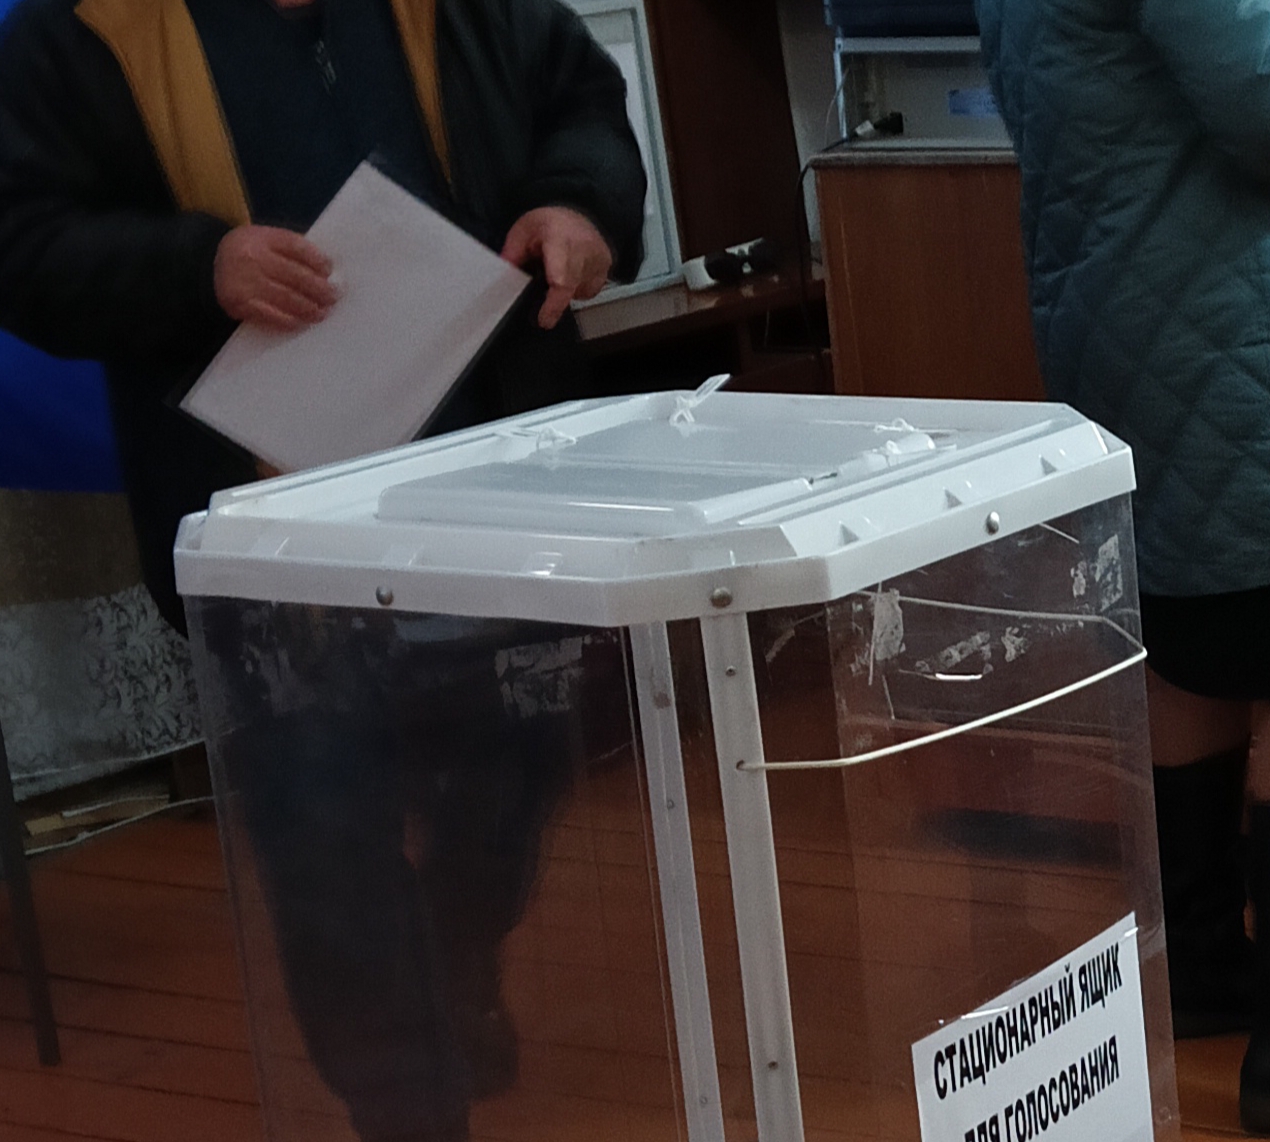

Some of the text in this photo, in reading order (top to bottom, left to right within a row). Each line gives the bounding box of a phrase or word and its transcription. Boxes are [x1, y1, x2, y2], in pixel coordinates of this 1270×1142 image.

[933, 941, 1123, 1101] СТАЦИОНАРНЫЙ ЯЩИК
[1004, 1034, 1120, 1142] ГОЛОСОВАНИЯ
